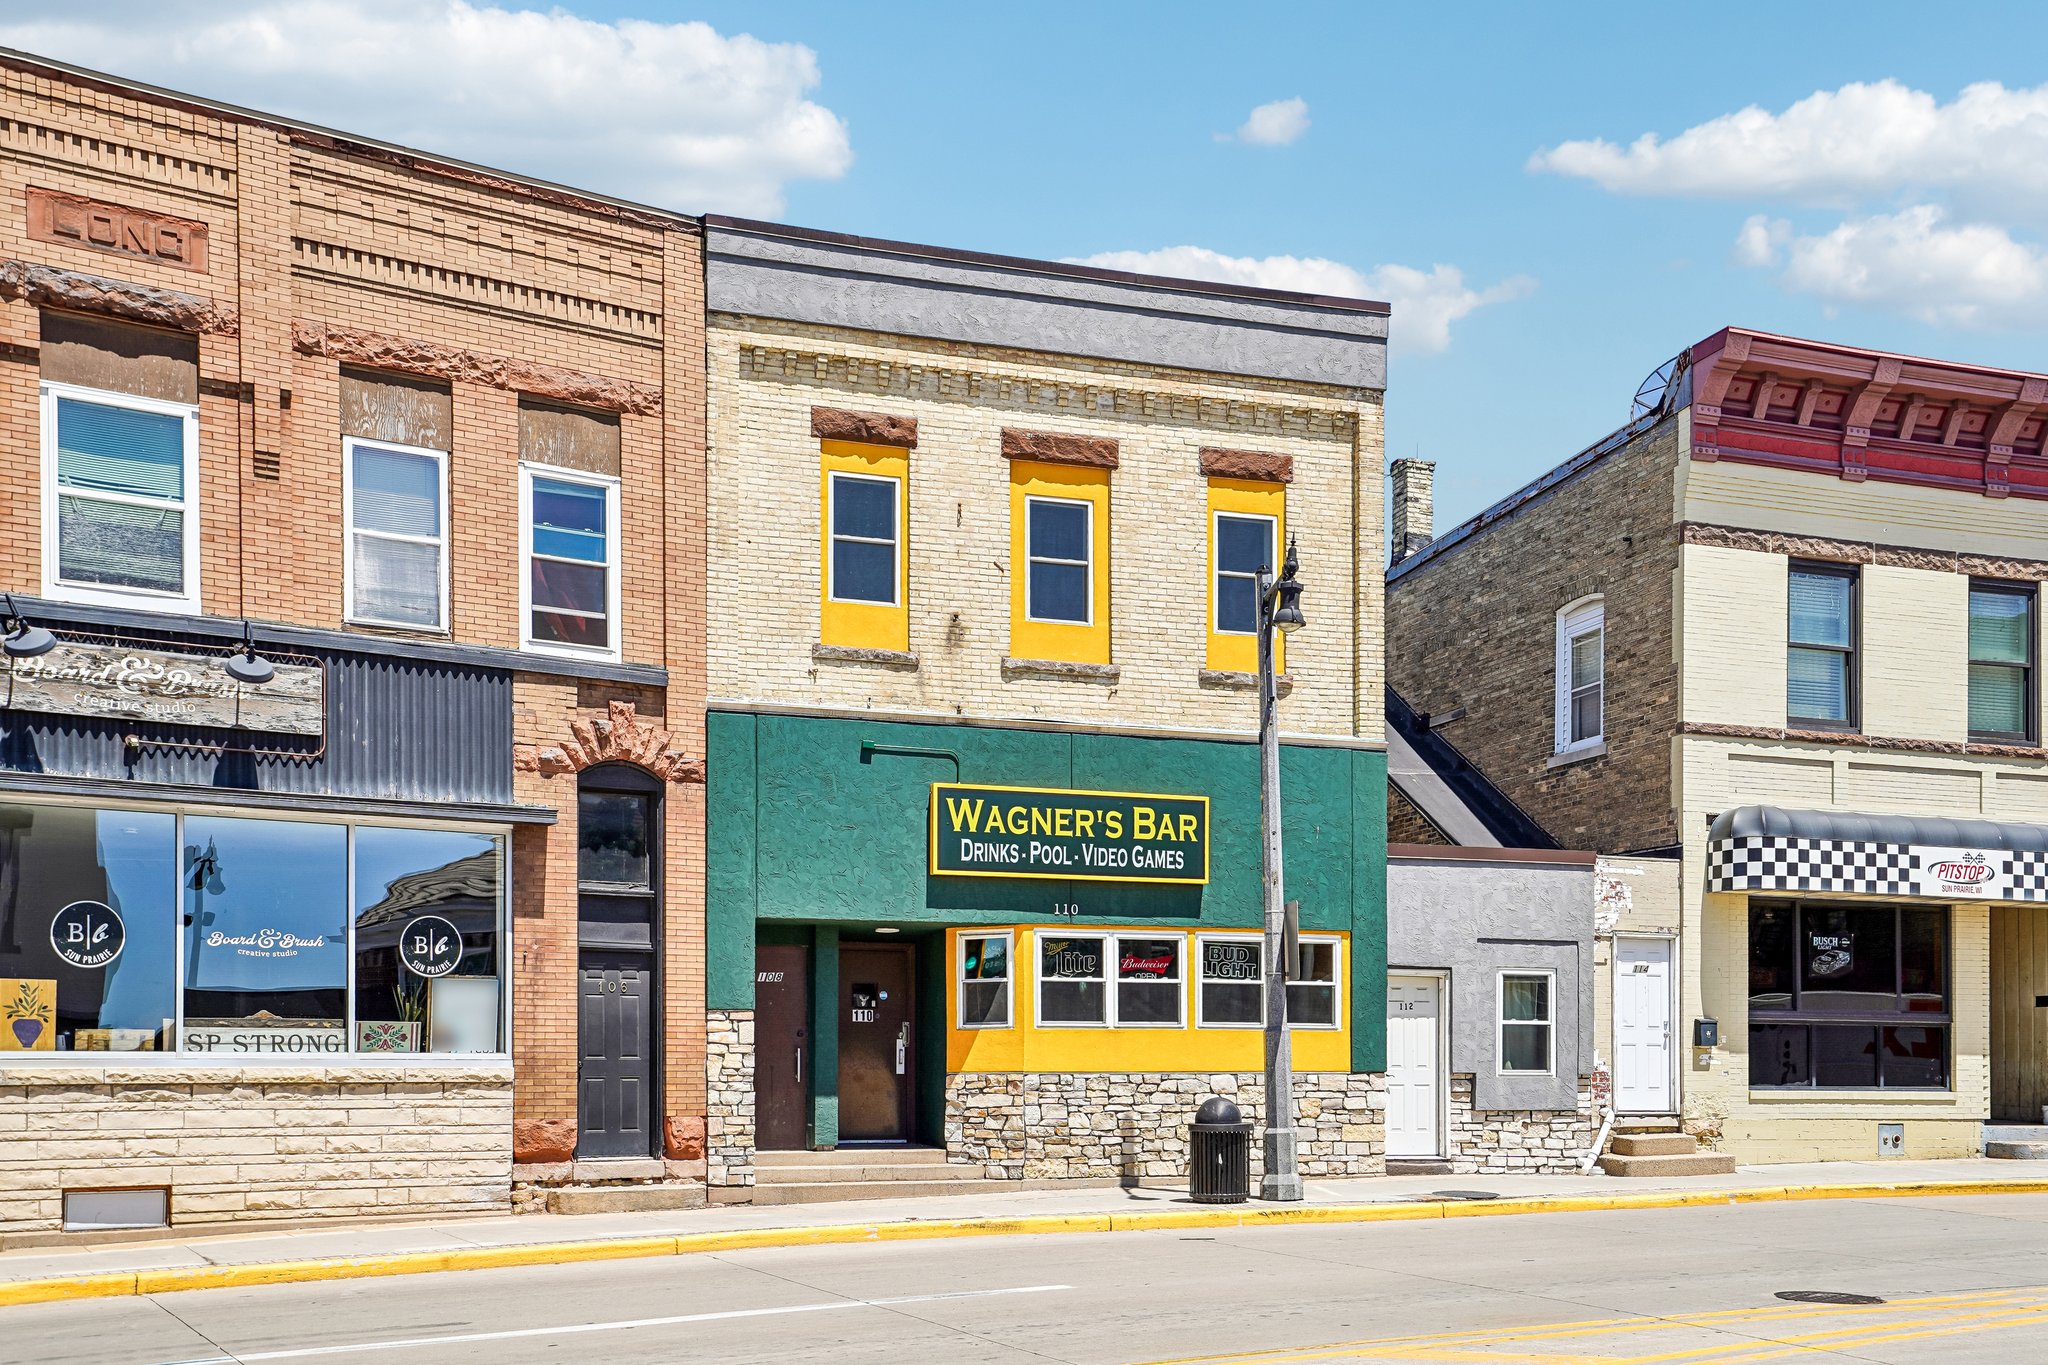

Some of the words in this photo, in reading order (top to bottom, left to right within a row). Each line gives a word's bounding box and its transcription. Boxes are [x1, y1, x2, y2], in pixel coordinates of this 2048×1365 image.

[117, 656, 163, 694] &
[74, 692, 141, 712] creative
[146, 699, 196, 713] studio
[1937, 863, 1985, 881] PITSTOP
[1941, 884, 1953, 893] SUN
[1054, 903, 1079, 915] 110
[207, 931, 257, 947] Board
[257, 928, 282, 949] &
[279, 933, 325, 949] Brush
[1813, 936, 1839, 947] BUSCH
[64, 949, 81, 962] SUN
[82, 948, 113, 964] PRAIRIE
[237, 948, 271, 957] creative
[272, 949, 298, 957] studio
[1208, 945, 1249, 962] BUD
[411, 960, 426, 973] SUN
[426, 960, 452, 974] PRAIRIE
[1054, 951, 1097, 978] Lite
[1120, 956, 1170, 970] Budweiser
[1632, 964, 1649, 974] 114
[757, 972, 784, 983] 108
[598, 980, 628, 993] 106
[1399, 1002, 1414, 1011] 112
[852, 1009, 874, 1022] 110
[187, 1033, 222, 1053] SP
[233, 1034, 341, 1053] STRONG
